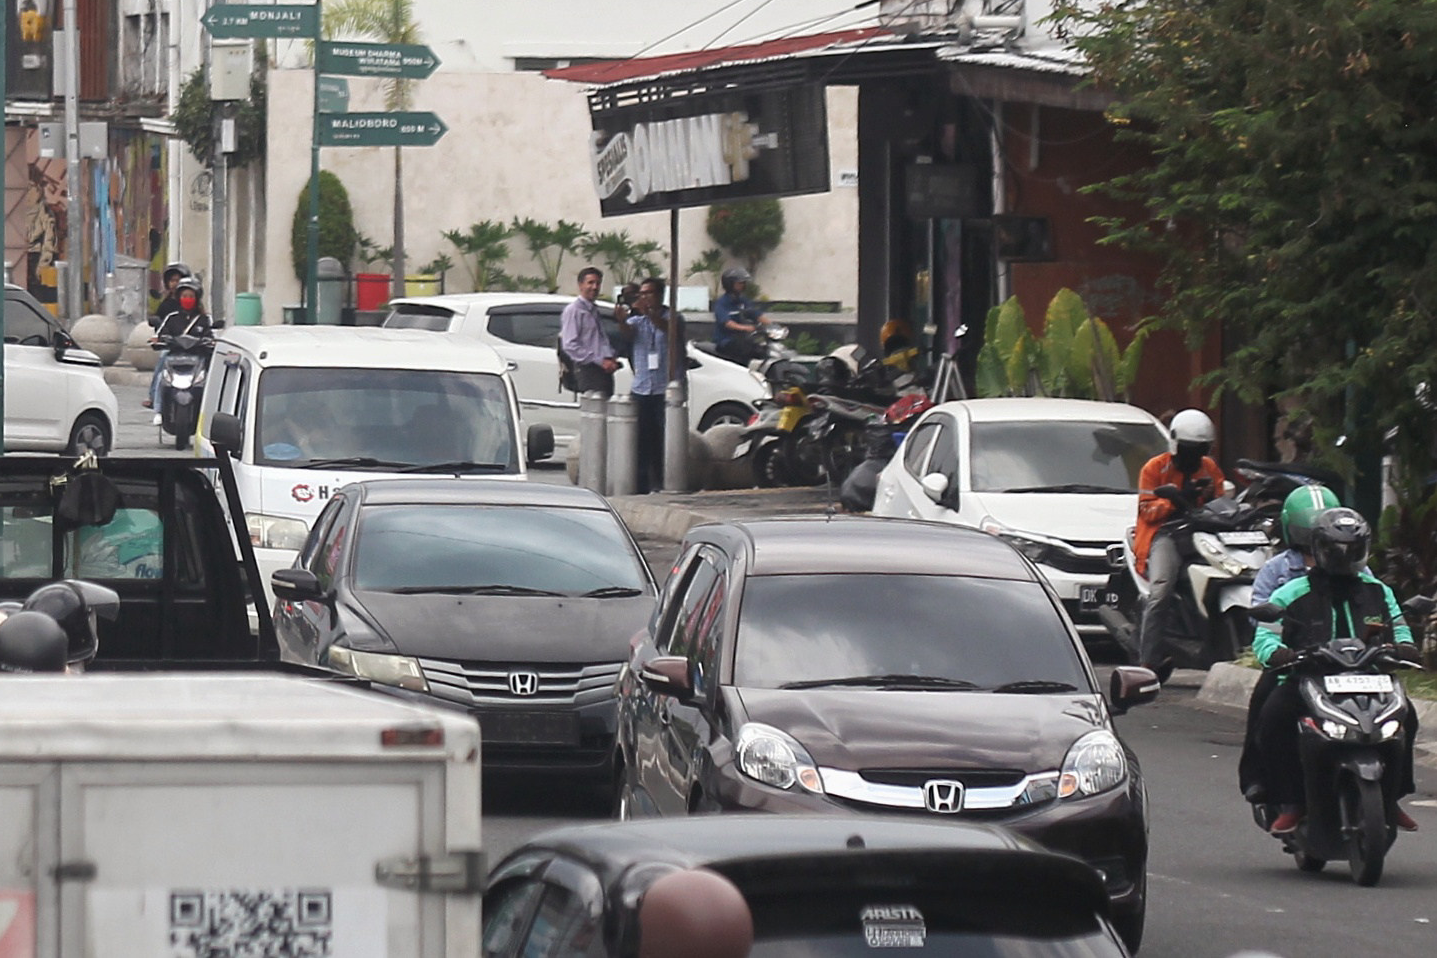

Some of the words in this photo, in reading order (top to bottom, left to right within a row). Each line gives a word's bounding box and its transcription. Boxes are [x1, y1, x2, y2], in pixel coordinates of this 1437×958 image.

[249, 10, 302, 21] MONJALI
[332, 47, 366, 57] MUSEUM
[332, 118, 398, 129] MALIOBORO
[1082, 588, 1097, 603] DK
